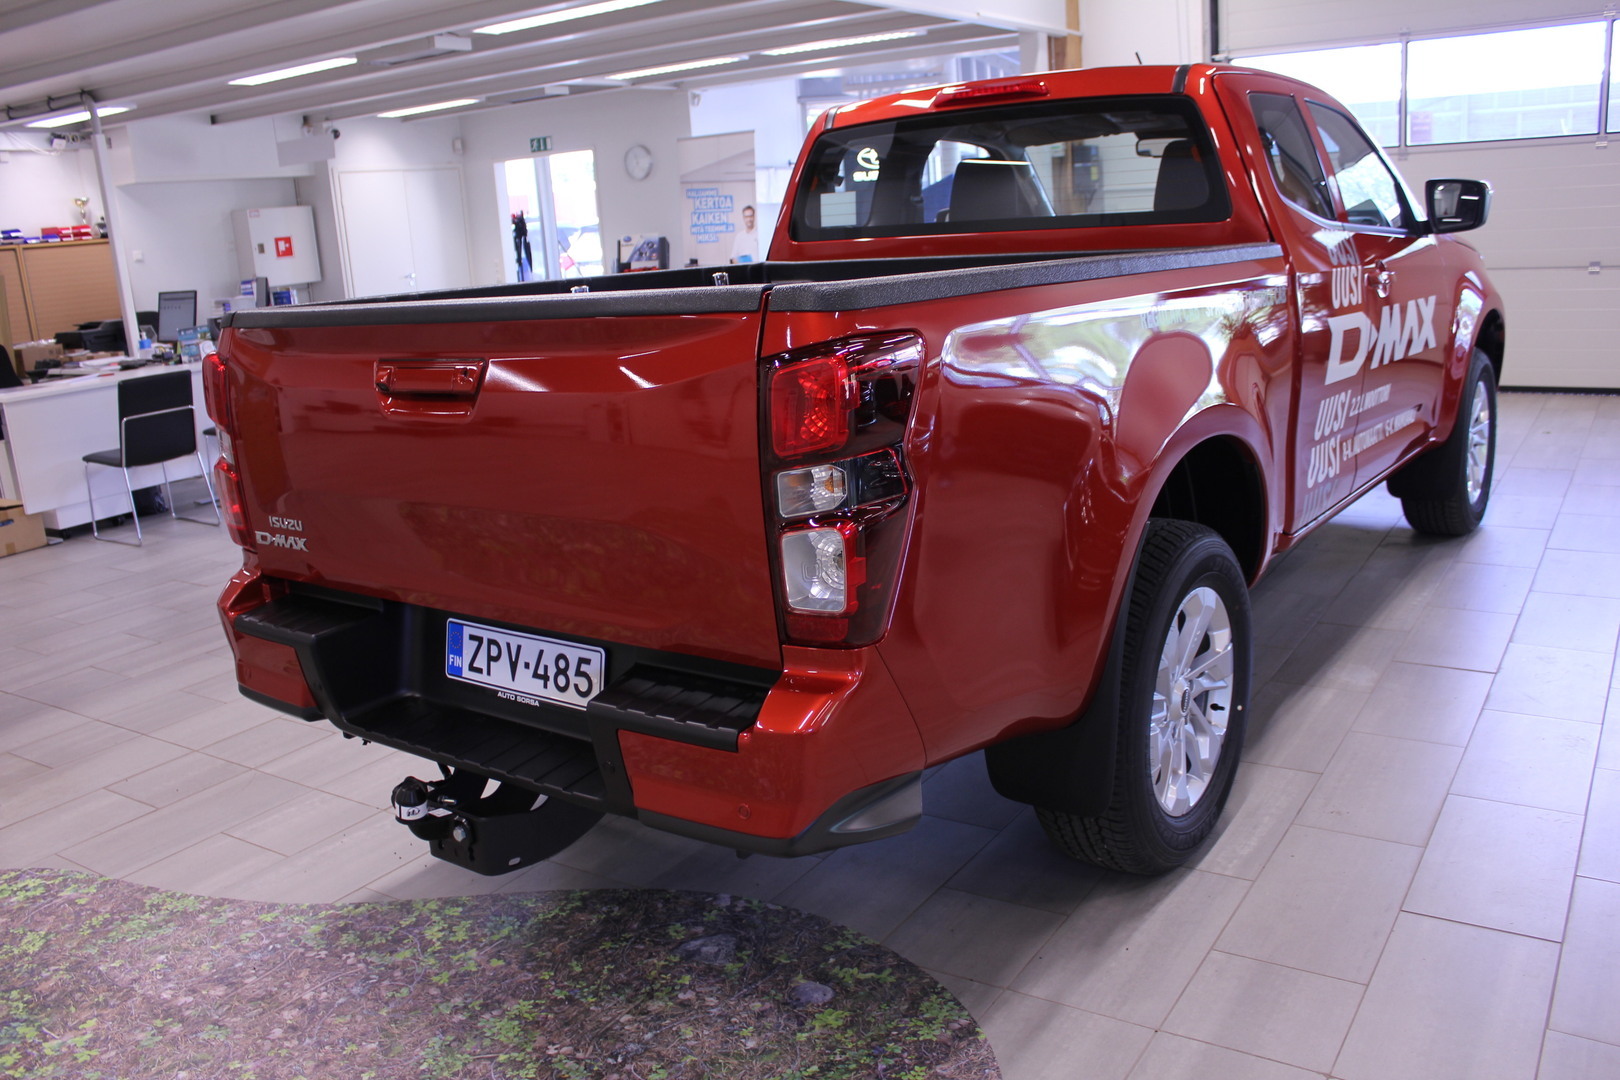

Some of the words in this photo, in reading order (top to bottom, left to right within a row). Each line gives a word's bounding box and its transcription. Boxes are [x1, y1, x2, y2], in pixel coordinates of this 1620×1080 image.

[695, 196, 732, 209] KERTOA
[692, 212, 727, 225] KAIKEN
[1331, 265, 1362, 310] UUSI
[1313, 389, 1352, 441] UUSI
[1306, 433, 1341, 489] UUSI
[268, 515, 304, 532] ISUZU
[449, 654, 463, 668] FIN
[468, 633, 594, 698] ZPV-485
[497, 691, 516, 701] AUTO
